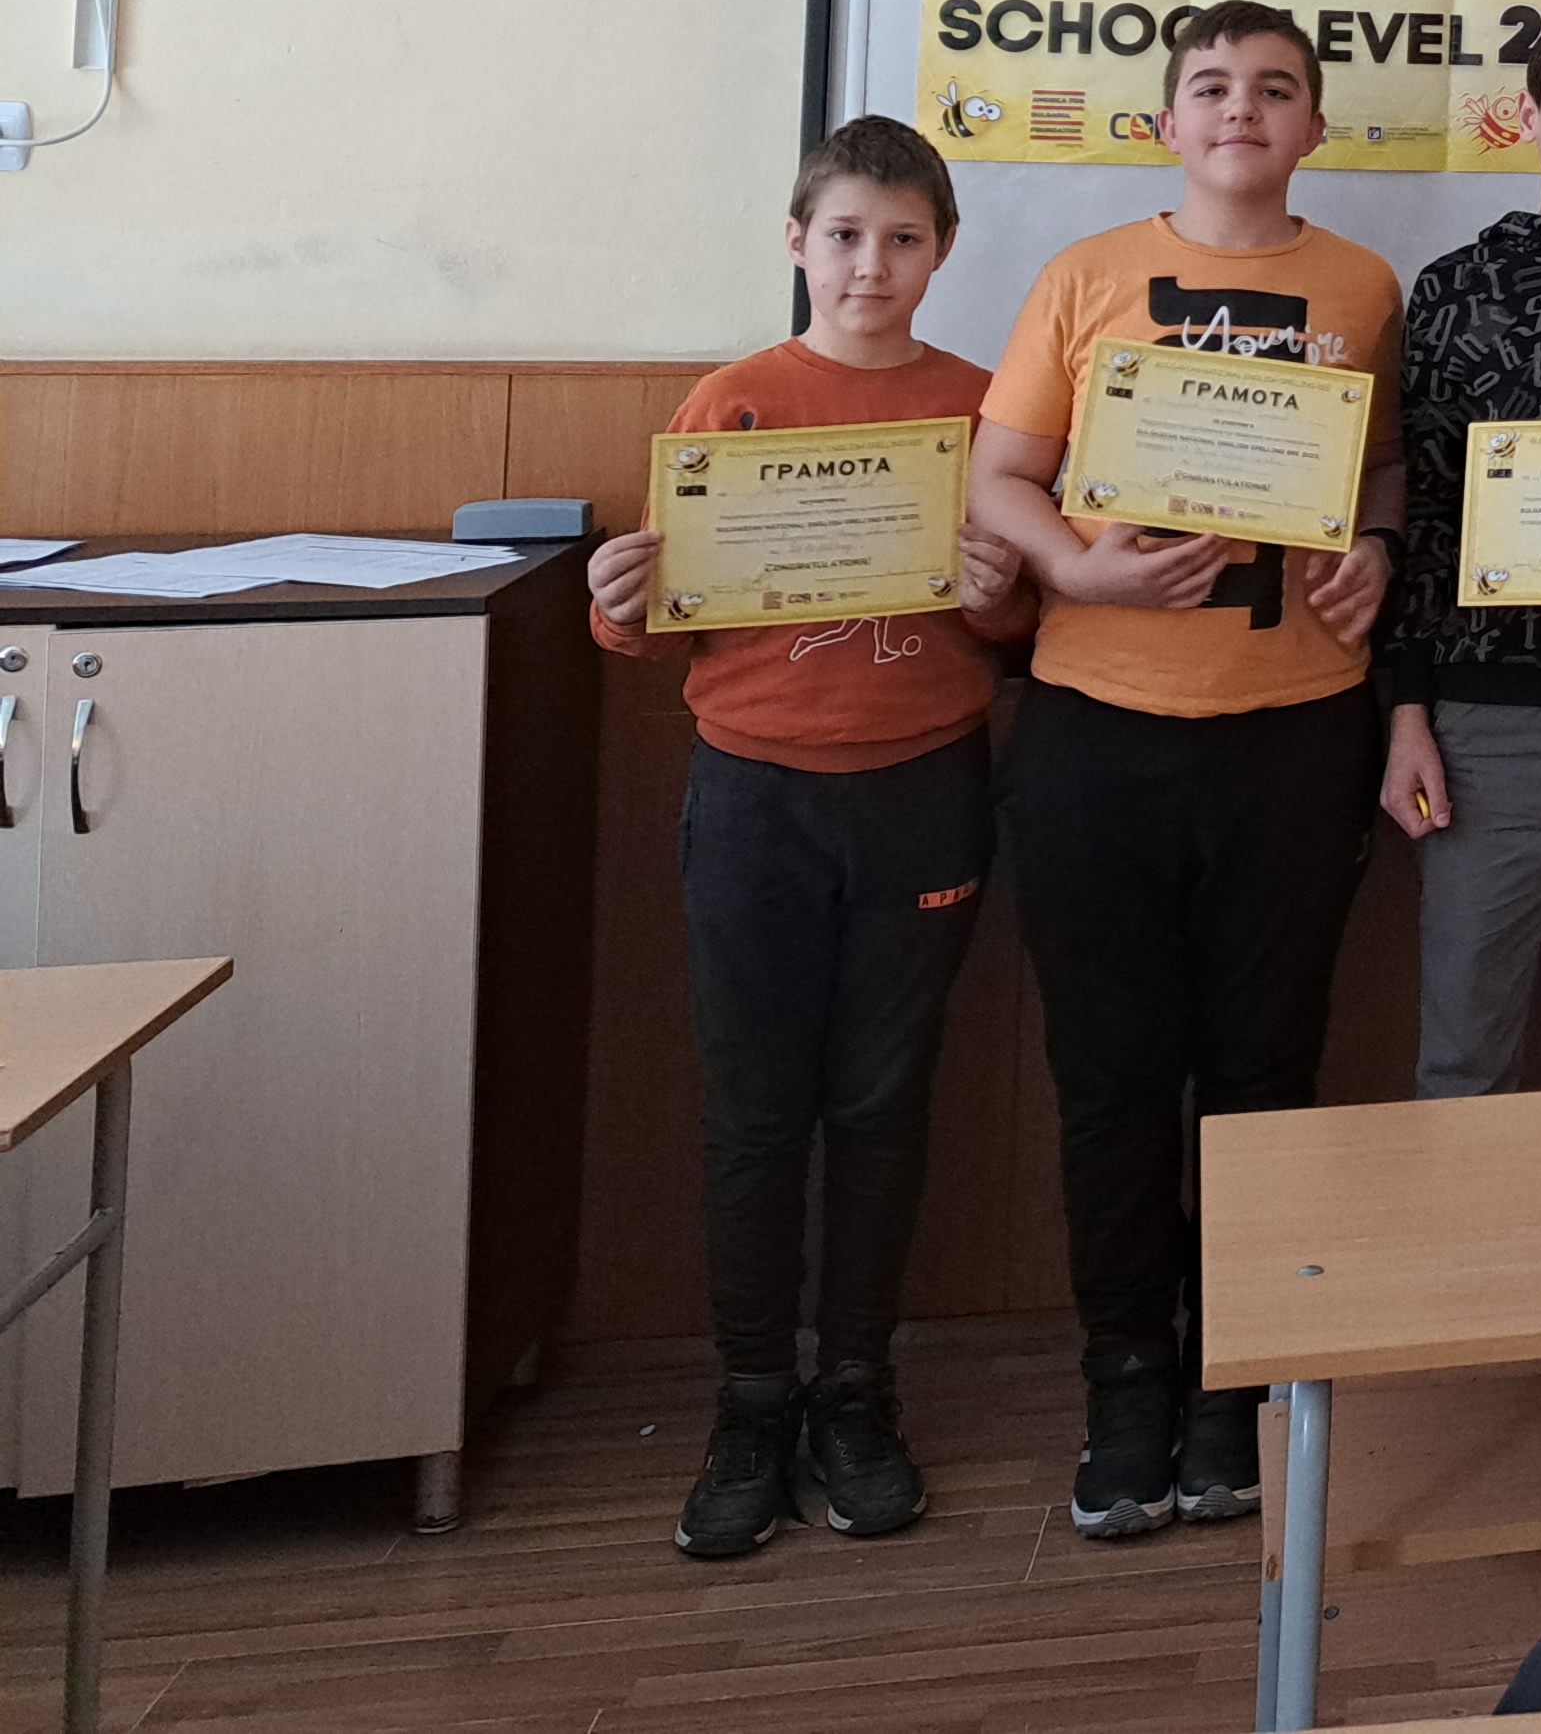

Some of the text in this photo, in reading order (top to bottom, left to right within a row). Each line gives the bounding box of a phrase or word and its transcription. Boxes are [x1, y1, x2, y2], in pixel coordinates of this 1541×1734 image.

[1279, 8, 1484, 67] EVEL
[1181, 379, 1300, 410] ГРАМОТА
[759, 457, 892, 481] ГРАМОТА
